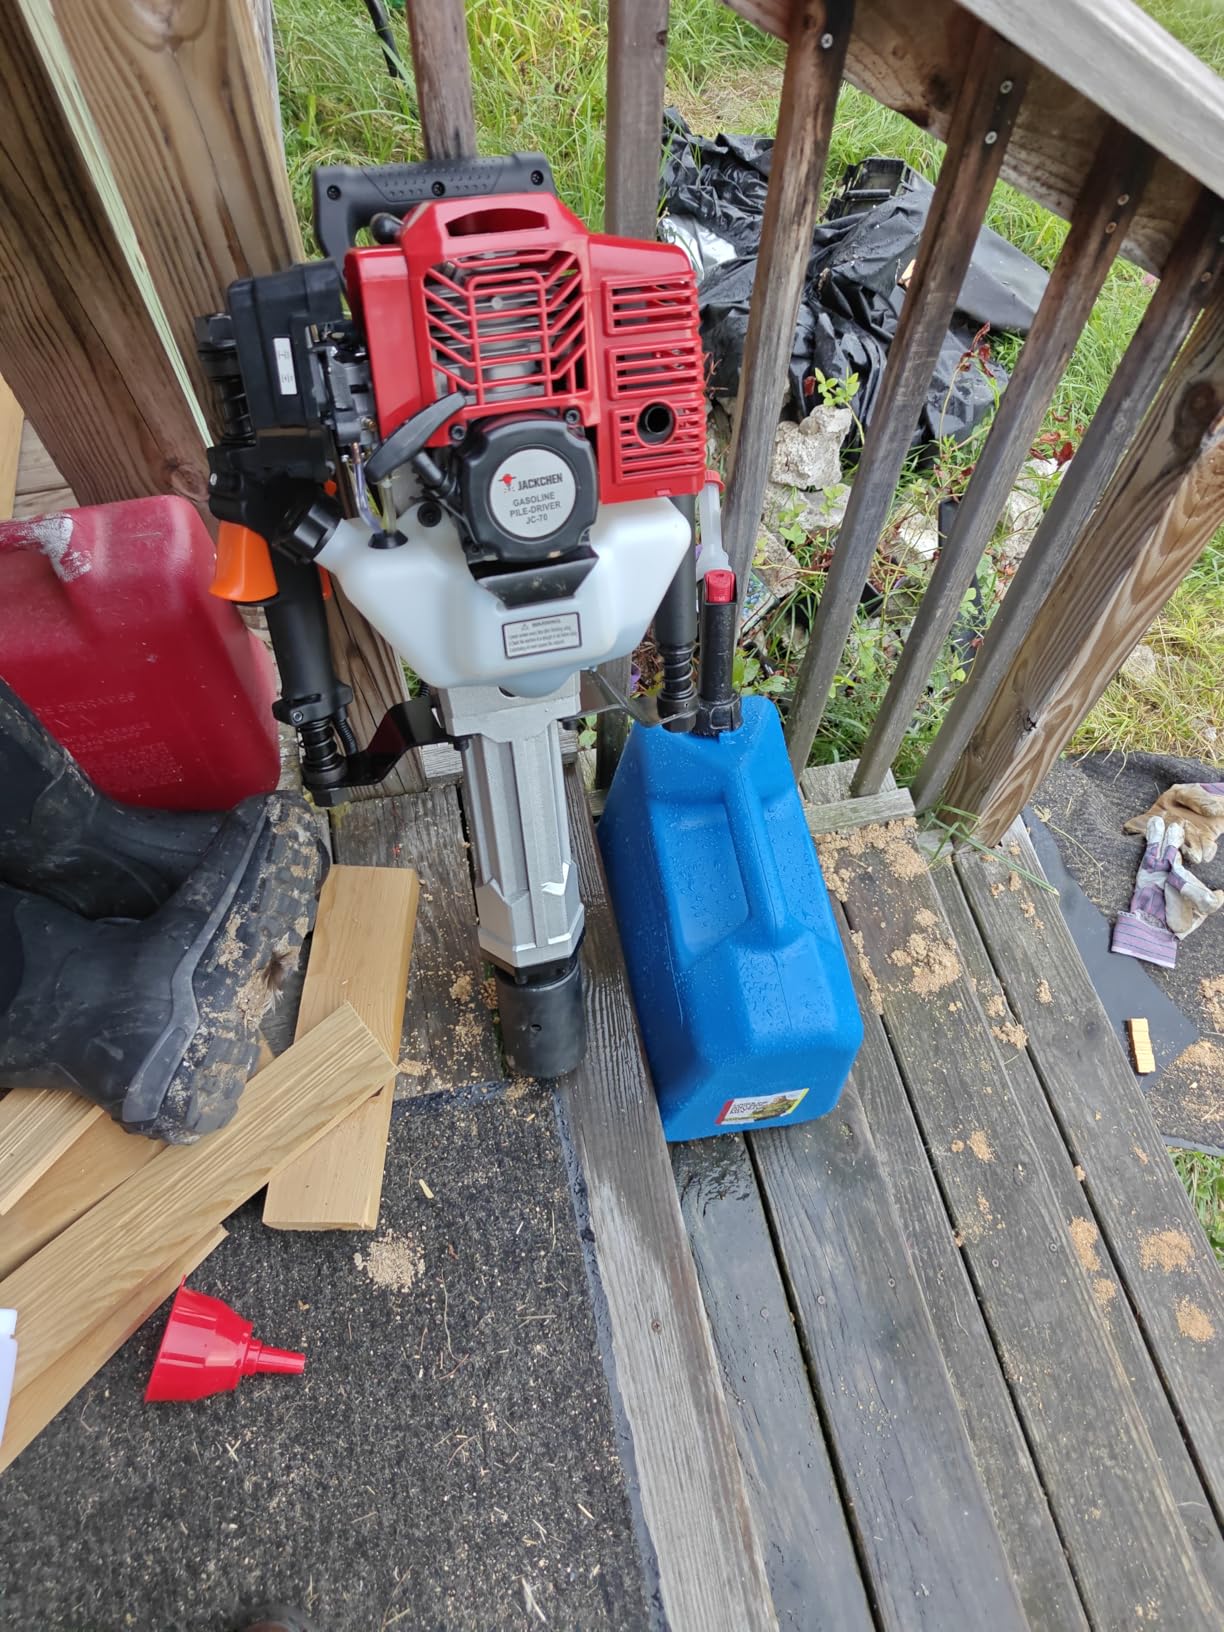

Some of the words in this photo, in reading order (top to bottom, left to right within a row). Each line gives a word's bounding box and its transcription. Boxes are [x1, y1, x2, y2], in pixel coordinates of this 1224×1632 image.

[518, 473, 563, 491] JACKCHEN
[513, 492, 555, 507] GASOLINE
[509, 501, 561, 517] PILE-DRIVER
[526, 513, 548, 525] JC-70
